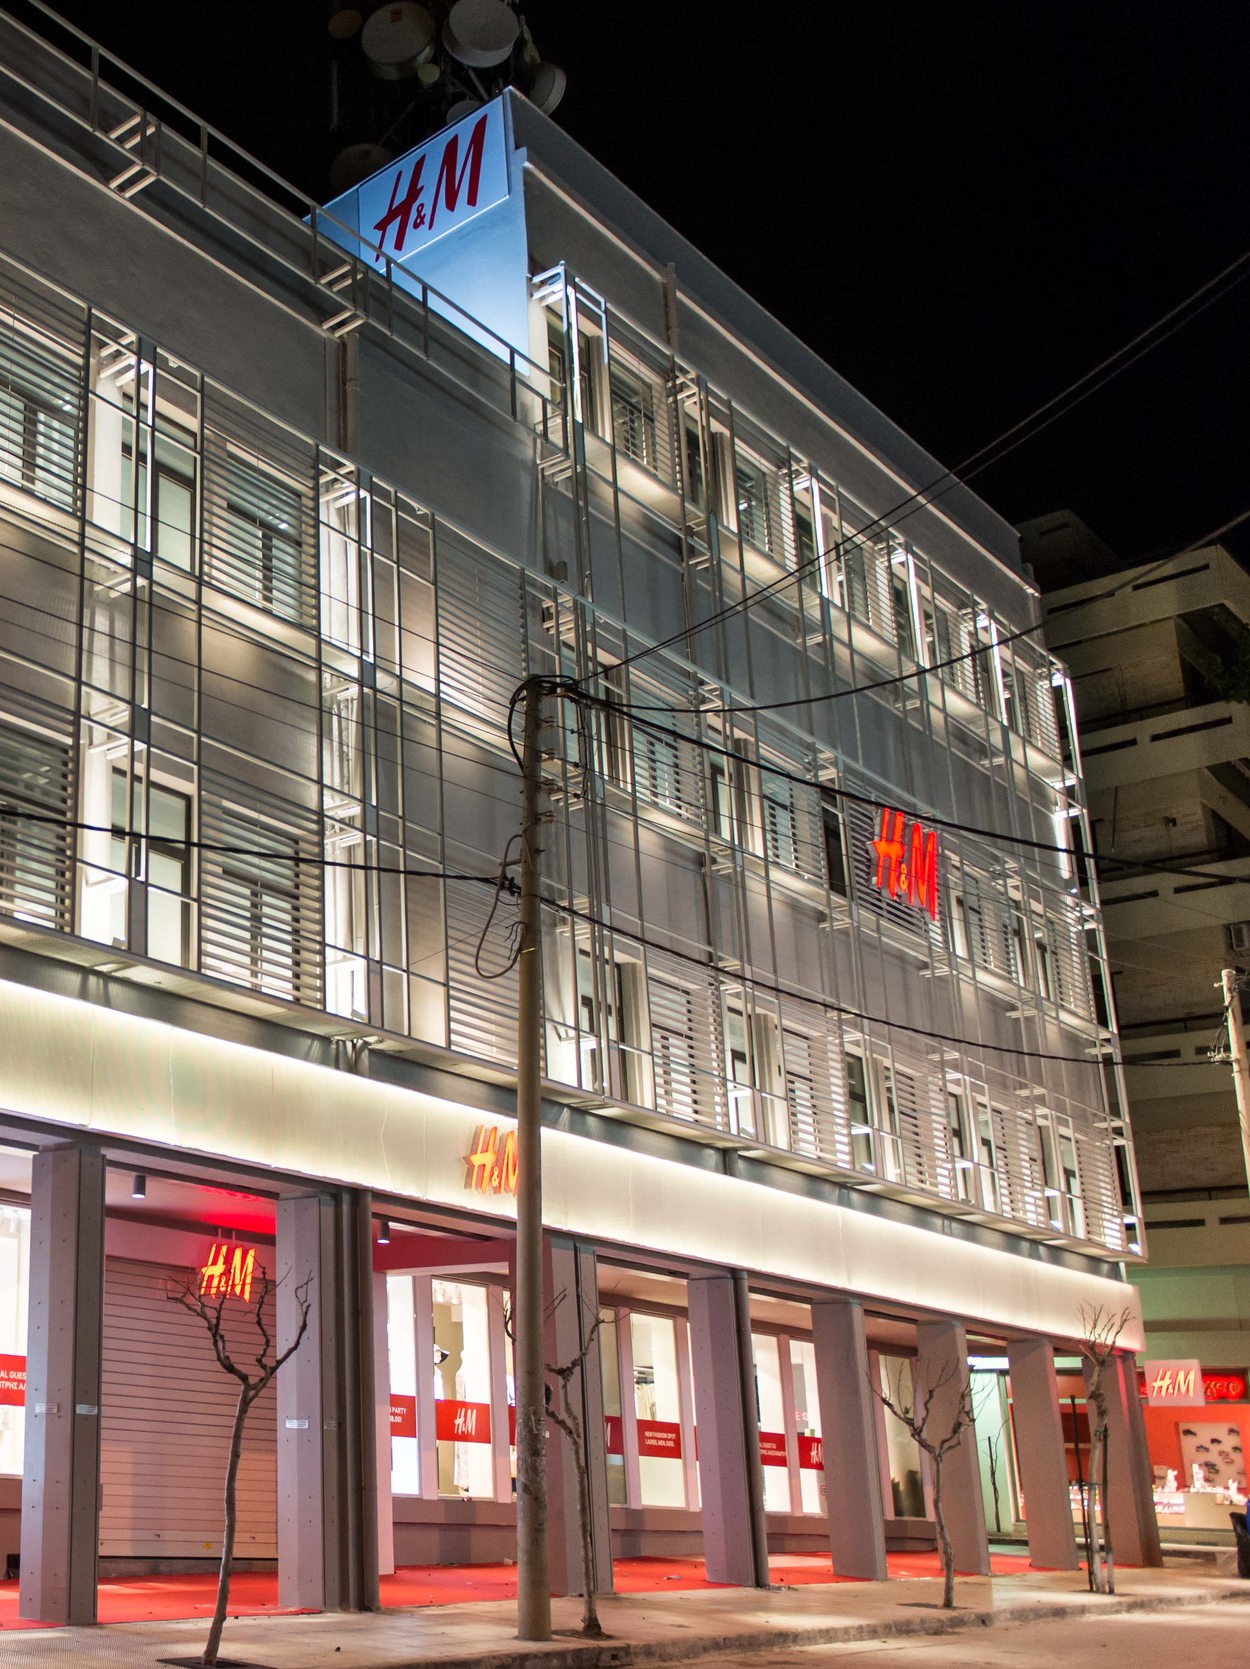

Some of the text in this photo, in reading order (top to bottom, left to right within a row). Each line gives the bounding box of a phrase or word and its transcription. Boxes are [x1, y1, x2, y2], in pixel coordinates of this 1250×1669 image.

[373, 113, 488, 263] H&M
[869, 806, 938, 922] H&M
[200, 1243, 256, 1303] H&M
[9, 1370, 26, 1381] GUES
[1151, 1368, 1196, 1398] H&M
[454, 1407, 477, 1436] H&M
